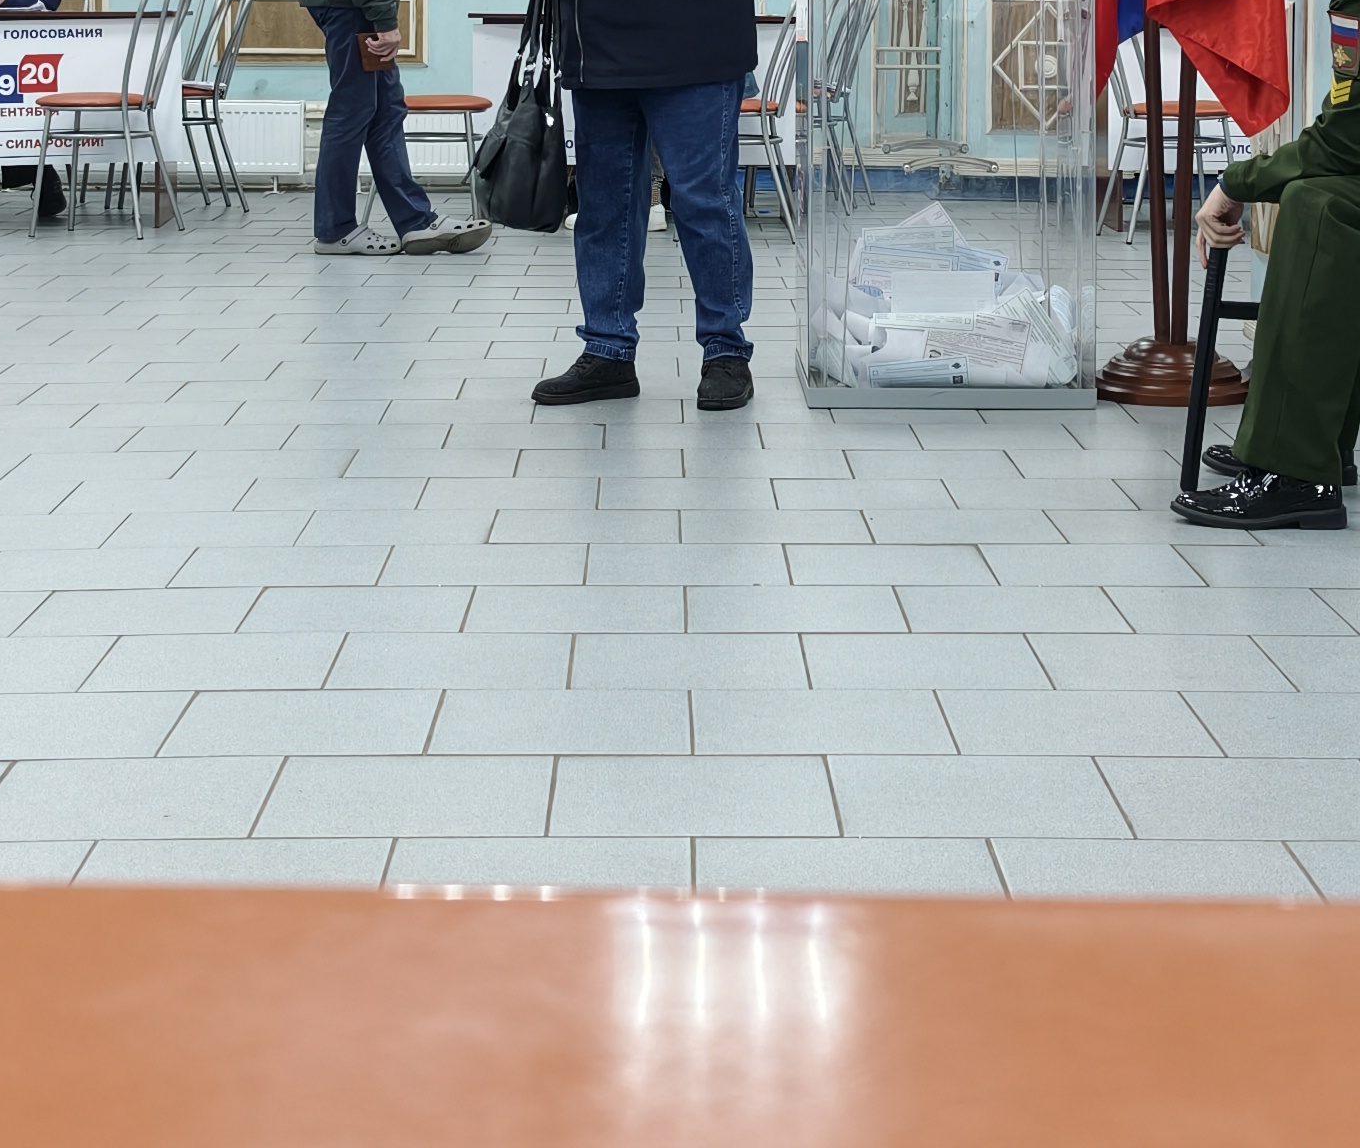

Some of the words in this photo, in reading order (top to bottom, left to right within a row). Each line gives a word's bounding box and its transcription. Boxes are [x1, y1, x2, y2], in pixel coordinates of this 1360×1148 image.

[3, 28, 103, 40] ГОЛОСОВАНИЯ
[21, 62, 56, 85] 20
[5, 138, 42, 149] СИЛА
